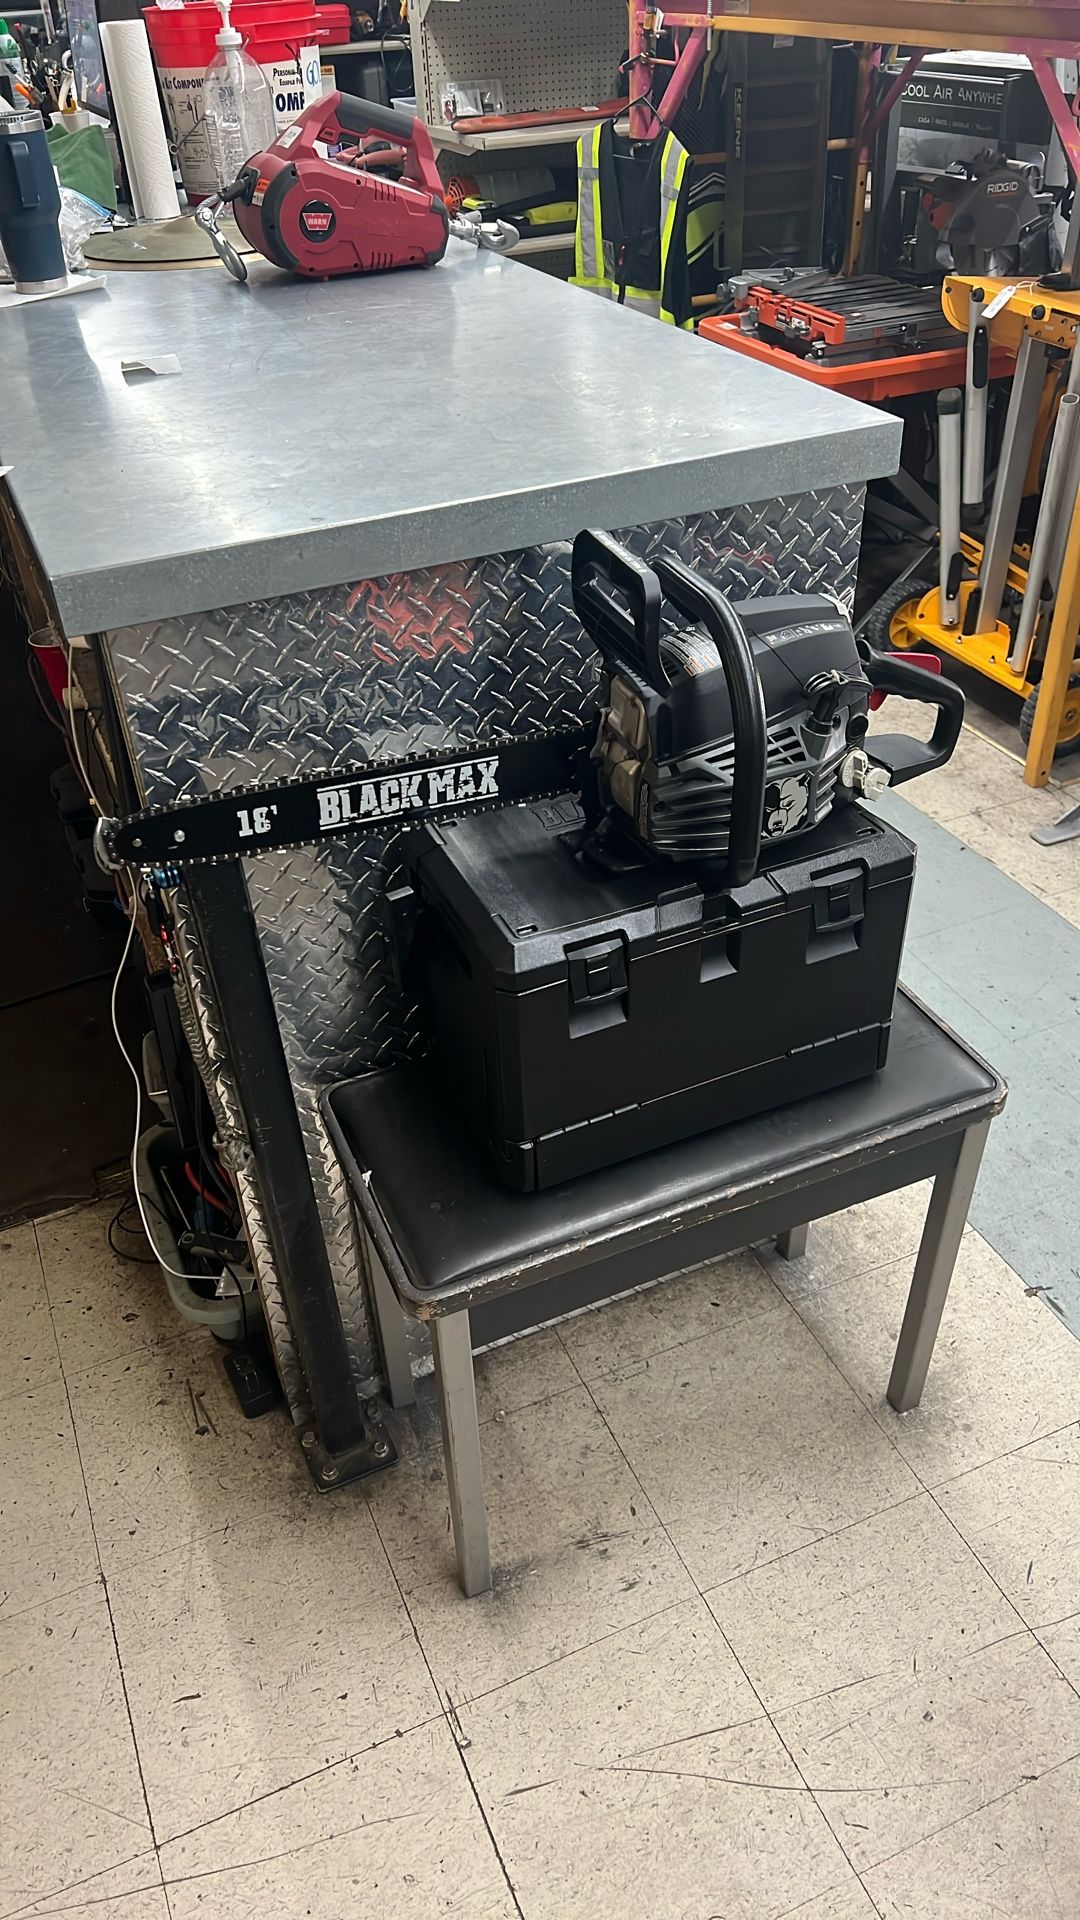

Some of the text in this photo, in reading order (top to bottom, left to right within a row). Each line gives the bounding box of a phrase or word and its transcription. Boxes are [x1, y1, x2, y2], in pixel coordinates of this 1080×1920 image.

[173, 75, 204, 89] COMPON
[933, 84, 953, 99] AIR
[275, 91, 305, 112] OMP
[987, 181, 1018, 194] RIDGID
[317, 760, 498, 826] BLACK MAX
